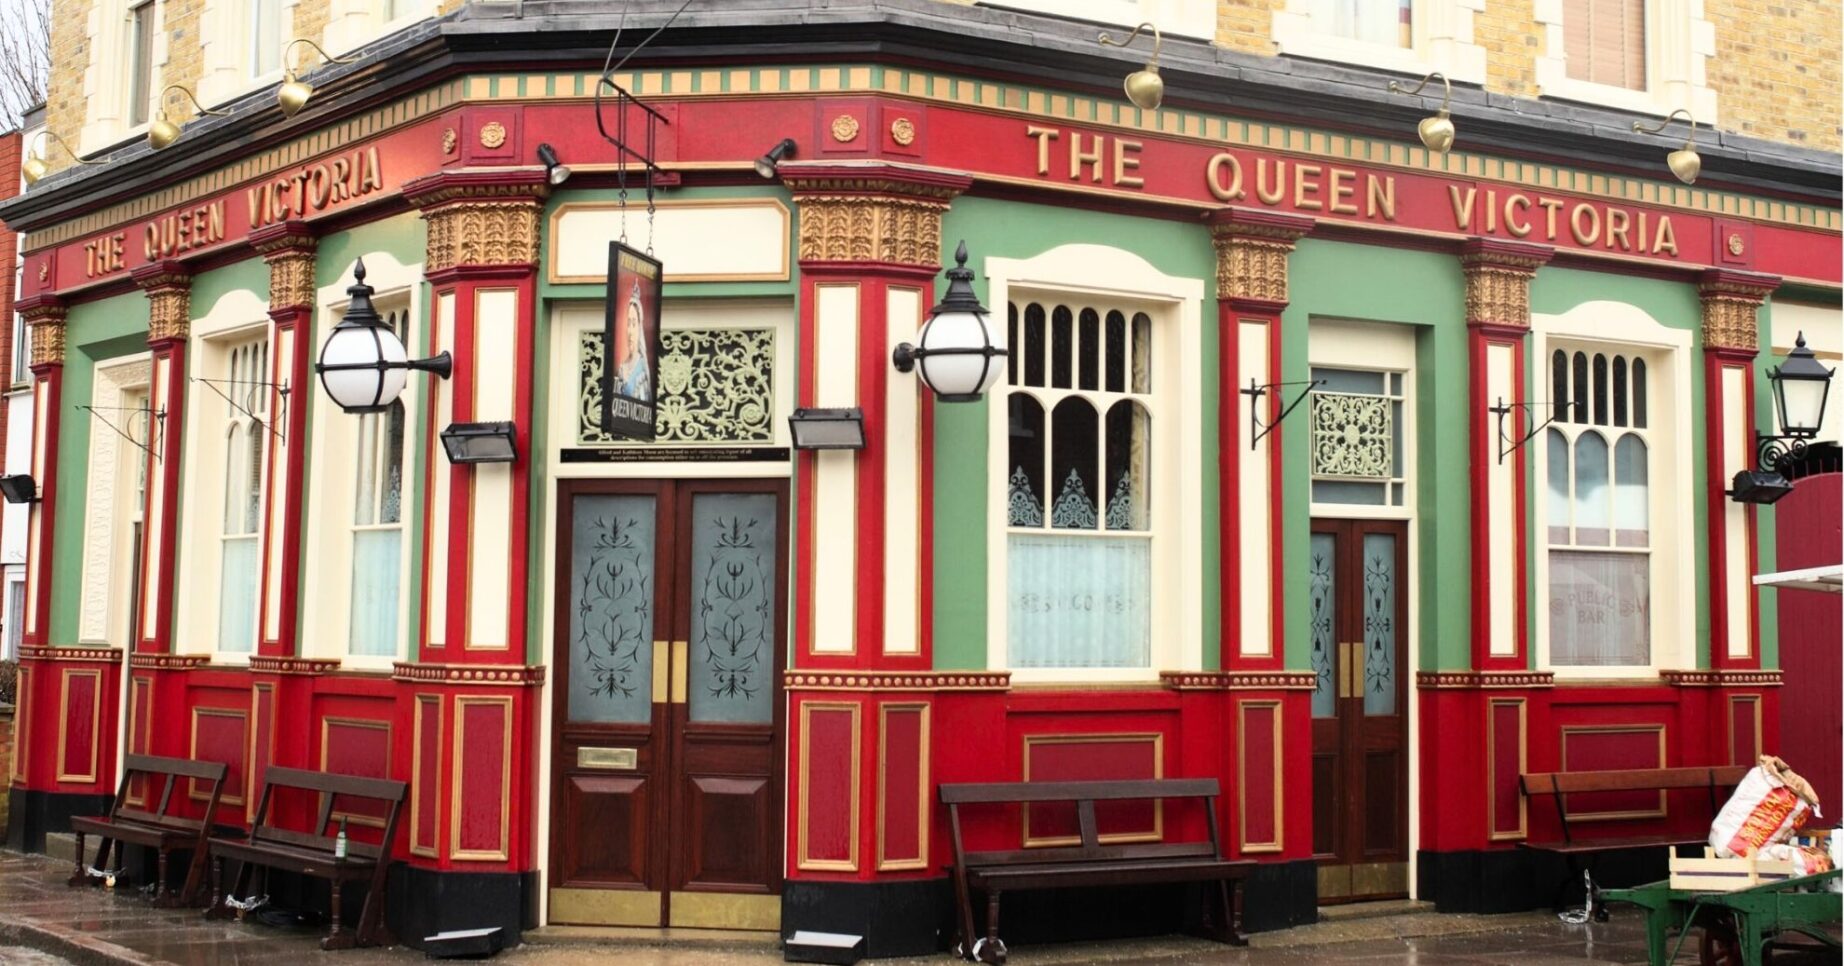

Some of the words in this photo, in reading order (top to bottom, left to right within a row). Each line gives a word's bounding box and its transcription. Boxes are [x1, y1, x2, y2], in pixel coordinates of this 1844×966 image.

[1027, 124, 1145, 188] THE
[1206, 152, 1396, 221] QUEEN
[1448, 184, 1679, 257] VICTORIA
[83, 231, 127, 278] THE
[143, 200, 225, 262] QUEEN
[247, 146, 384, 229] VICTORIA
[612, 397, 630, 420] QUEEN
[630, 402, 652, 424] VICTORIA
[1567, 590, 1617, 609] PUBLIC
[1577, 610, 1606, 624] BAR
